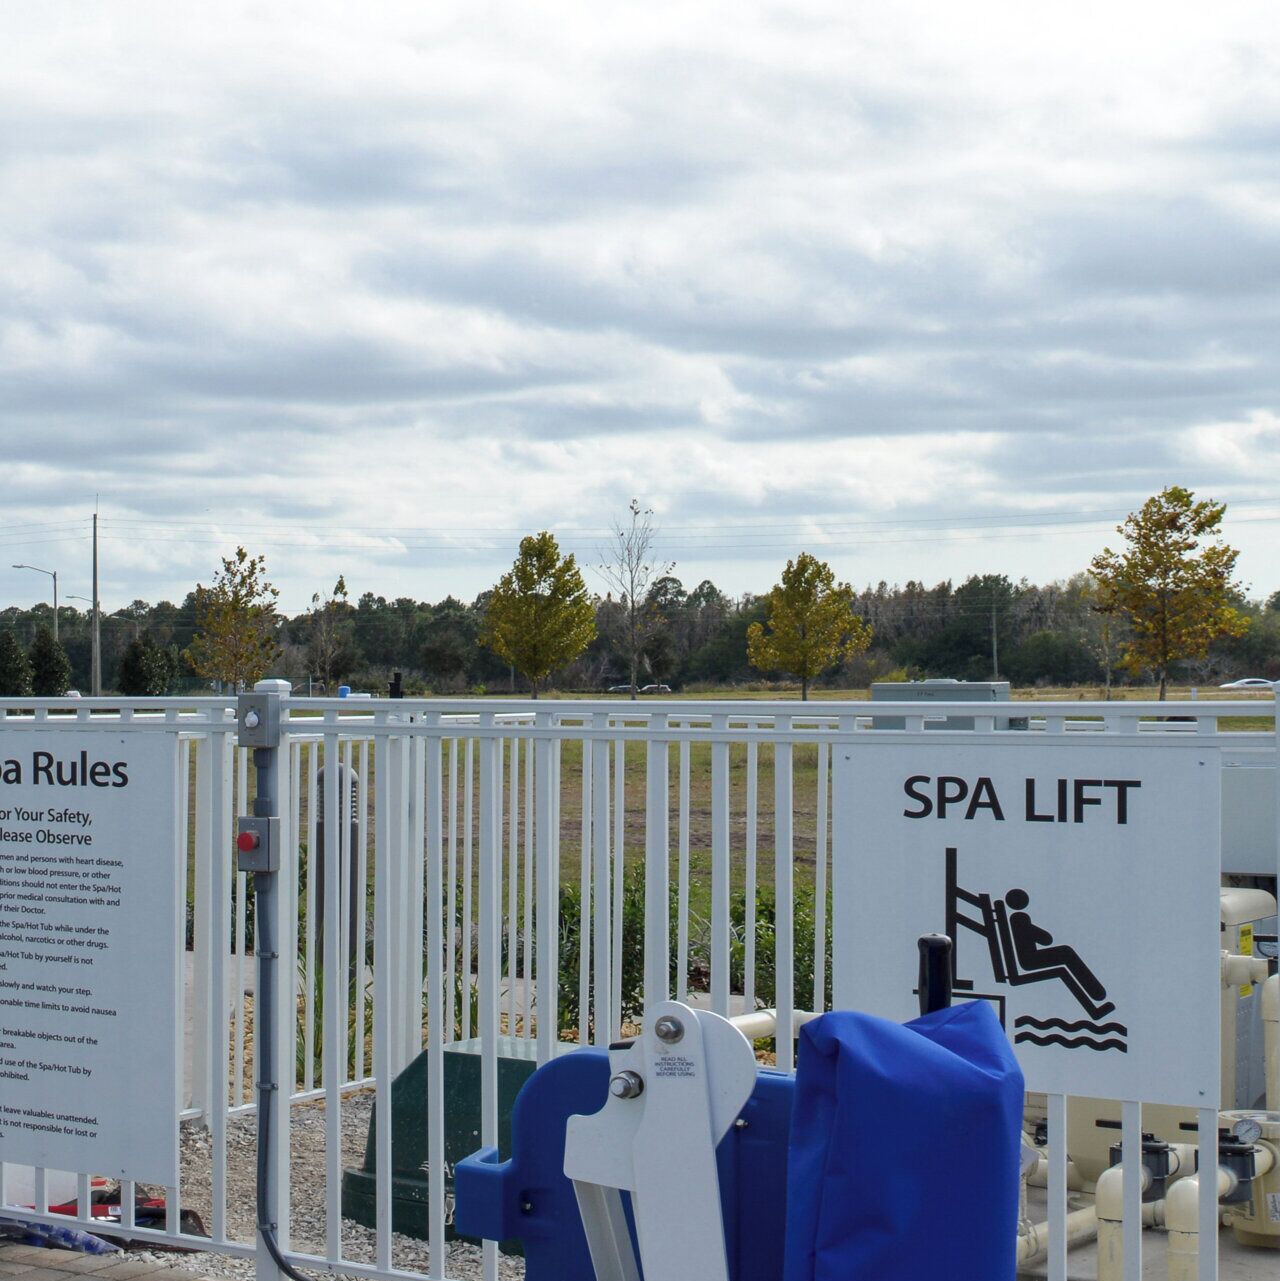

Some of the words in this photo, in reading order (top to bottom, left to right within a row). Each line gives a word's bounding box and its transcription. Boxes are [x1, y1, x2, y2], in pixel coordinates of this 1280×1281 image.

[33, 751, 129, 787] Rules
[903, 775, 1006, 820] SPA
[1026, 778, 1142, 824] LIFT
[15, 808, 44, 821] Your
[48, 809, 93, 827] Safety,
[36, 830, 93, 845] Observe
[76, 857, 94, 865] heart
[96, 858, 123, 867] disease,
[28, 867, 48, 875] blood
[91, 871, 110, 879] other
[22, 880, 44, 888] should
[93, 884, 121, 893] Spa/Hot
[0, 892, 15, 900] prior
[17, 893, 43, 901] medical
[21, 906, 45, 914] Doctor.
[12, 921, 38, 930] Spa/Hot
[40, 923, 53, 931] Tub
[55, 924, 73, 932] while
[75, 926, 96, 934] under
[87, 940, 108, 949] drugs.
[35, 953, 43, 962] by
[74, 956, 79, 964] is
[0, 980, 20, 990] slowly
[76, 988, 92, 996] step.
[42, 1002, 60, 1010] limits
[3, 1028, 36, 1038] breakable
[38, 1032, 62, 1041] objects
[86, 1037, 98, 1045] the
[26, 1061, 37, 1069] the
[39, 1062, 66, 1072] Spa/Hot
[68, 1066, 81, 1074] Tub
[83, 1067, 92, 1077] by
[4, 1106, 21, 1114] leave
[23, 1109, 54, 1119] valuables
[56, 1115, 98, 1125] unattended.
[23, 1123, 62, 1133] responsible
[64, 1126, 73, 1134] for
[75, 1128, 88, 1136] lost
